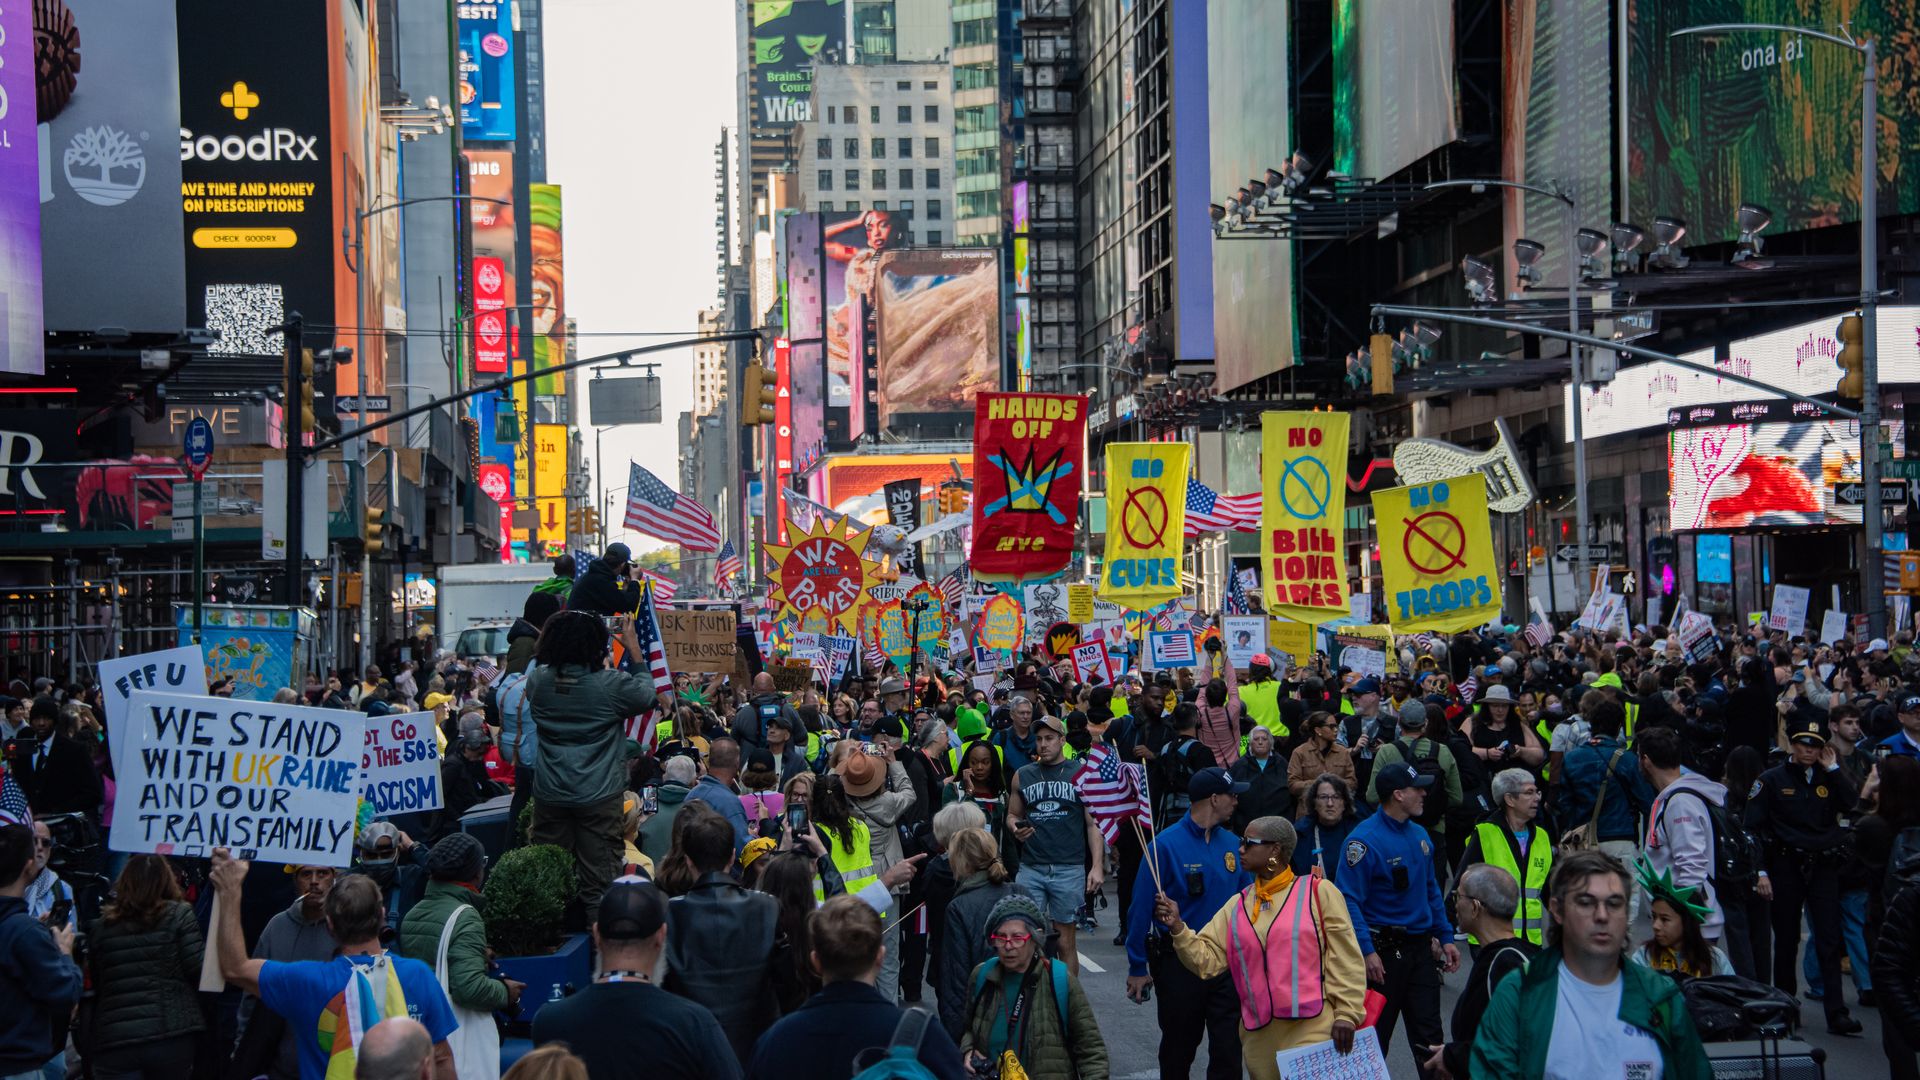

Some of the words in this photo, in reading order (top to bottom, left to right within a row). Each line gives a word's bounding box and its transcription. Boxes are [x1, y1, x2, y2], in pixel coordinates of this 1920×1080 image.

[458, 6, 497, 20] EST!
[1741, 35, 1805, 71] ona.ai
[767, 71, 804, 82] Brains.
[181, 127, 318, 161] GoodRx
[182, 183, 205, 196] AVE
[208, 183, 238, 196] TIME
[240, 183, 267, 196] AND
[269, 183, 314, 196] MONEY
[184, 201, 204, 212] ON
[206, 200, 304, 212] PRESCRIPTIONS
[213, 235, 239, 243] CHECK
[245, 235, 277, 243] GOODRX
[342, 401, 359, 409] ONE
[366, 400, 385, 408] WAY
[988, 397, 1078, 421] HANDS
[1012, 421, 1053, 439] OFF
[1288, 427, 1323, 447] NO
[1131, 458, 1164, 478] NO
[1906, 464, 1916, 476] 41
[1409, 482, 1450, 508] NO
[1845, 489, 1864, 498] ONE
[995, 536, 1046, 552] NYC
[1273, 528, 1335, 554] BILL
[794, 539, 846, 567] WE
[823, 567, 841, 575] THE
[1109, 558, 1176, 587] CUTS
[1273, 555, 1338, 581] IONA
[787, 577, 860, 615] POWER
[872, 587, 905, 599] RIBUS
[1276, 583, 1343, 607] IRES
[1396, 575, 1492, 619] TROOPS
[1093, 602, 1117, 610] ANANAS
[692, 615, 735, 631] TRUMP
[796, 635, 815, 646] with
[1079, 646, 1096, 656] NO
[1077, 653, 1102, 662] KINGS
[166, 662, 186, 686] U
[151, 707, 217, 746] WE
[228, 711, 341, 758] STAND
[376, 746, 402, 769] THE
[141, 748, 226, 782] WITH
[231, 752, 358, 793] UKRAINE
[139, 783, 209, 810] AND
[216, 785, 291, 813] OUR
[360, 775, 437, 815] ASCISM
[1022, 781, 1045, 804] NEW
[1047, 781, 1077, 803] YORK
[1013, 992, 1024, 1017] SONY
